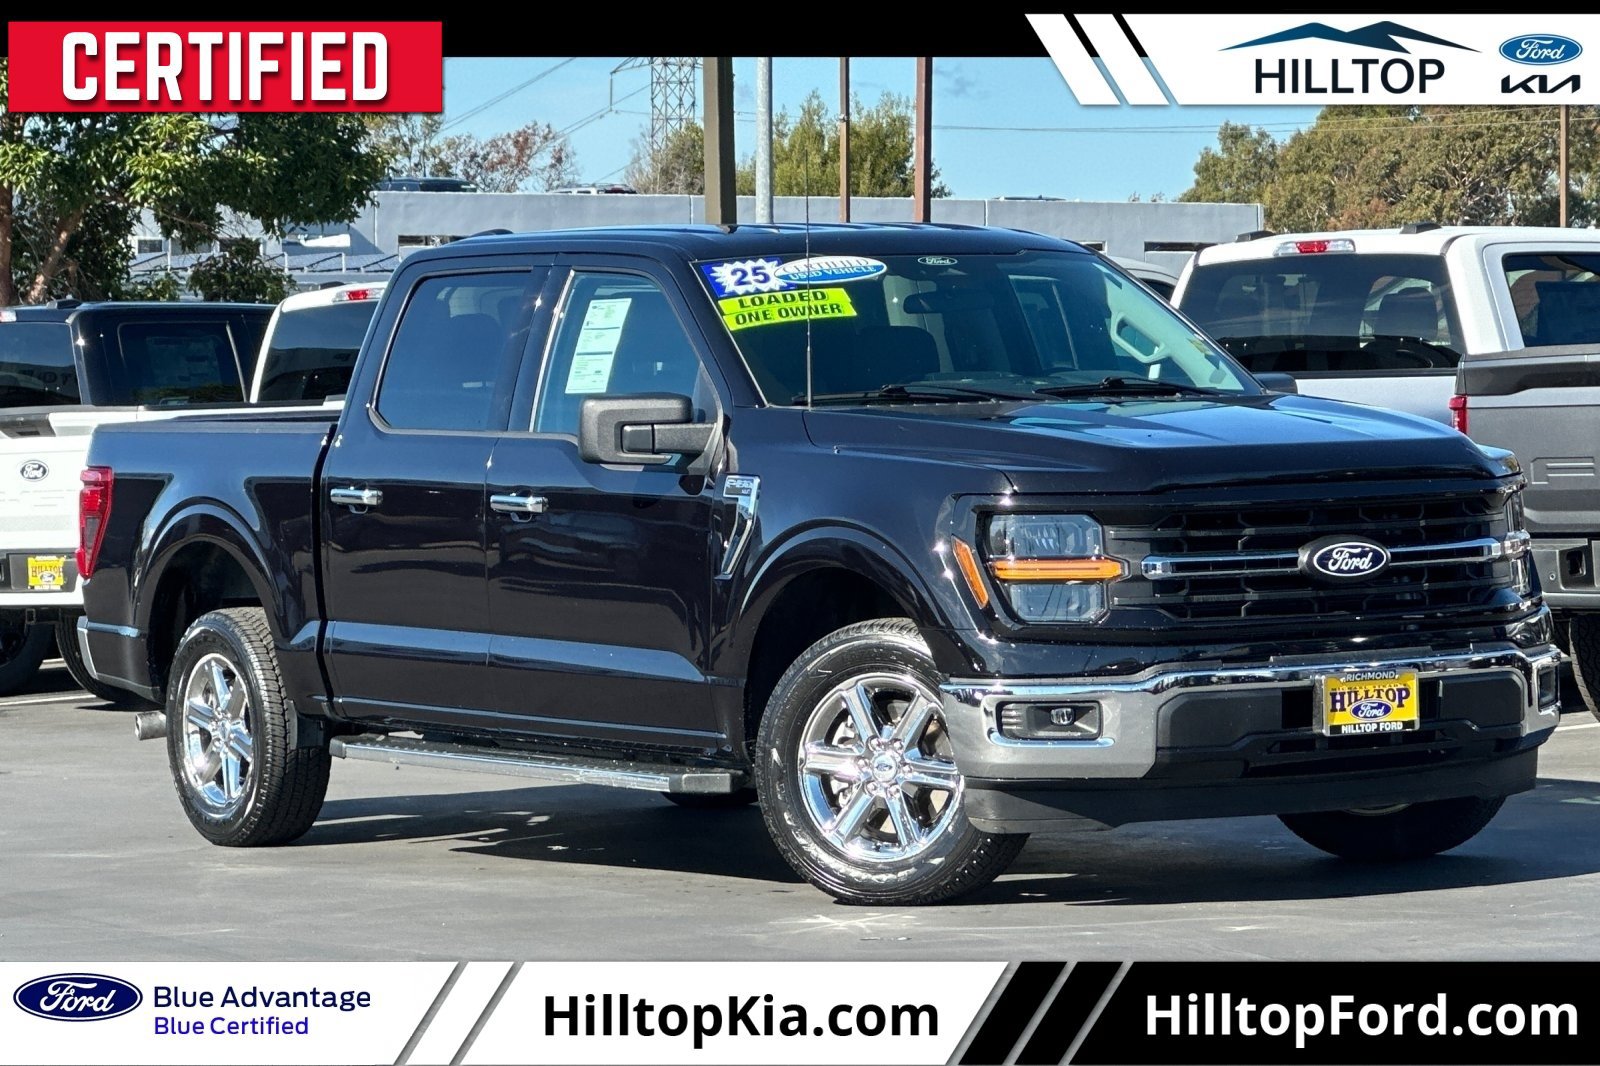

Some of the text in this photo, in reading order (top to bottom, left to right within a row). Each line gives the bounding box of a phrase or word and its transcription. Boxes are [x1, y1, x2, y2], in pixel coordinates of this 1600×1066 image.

[730, 265, 771, 287] 25
[789, 265, 877, 280] USED VEHICLE
[739, 290, 827, 309] LOADED
[735, 302, 842, 326] ONE OWNER
[1328, 547, 1373, 571] Ford
[1346, 671, 1395, 681] RICHMOND
[1330, 687, 1410, 712] HILLTOP
[1358, 702, 1384, 718] Ford
[1341, 721, 1403, 734] HILLTOP FORD
